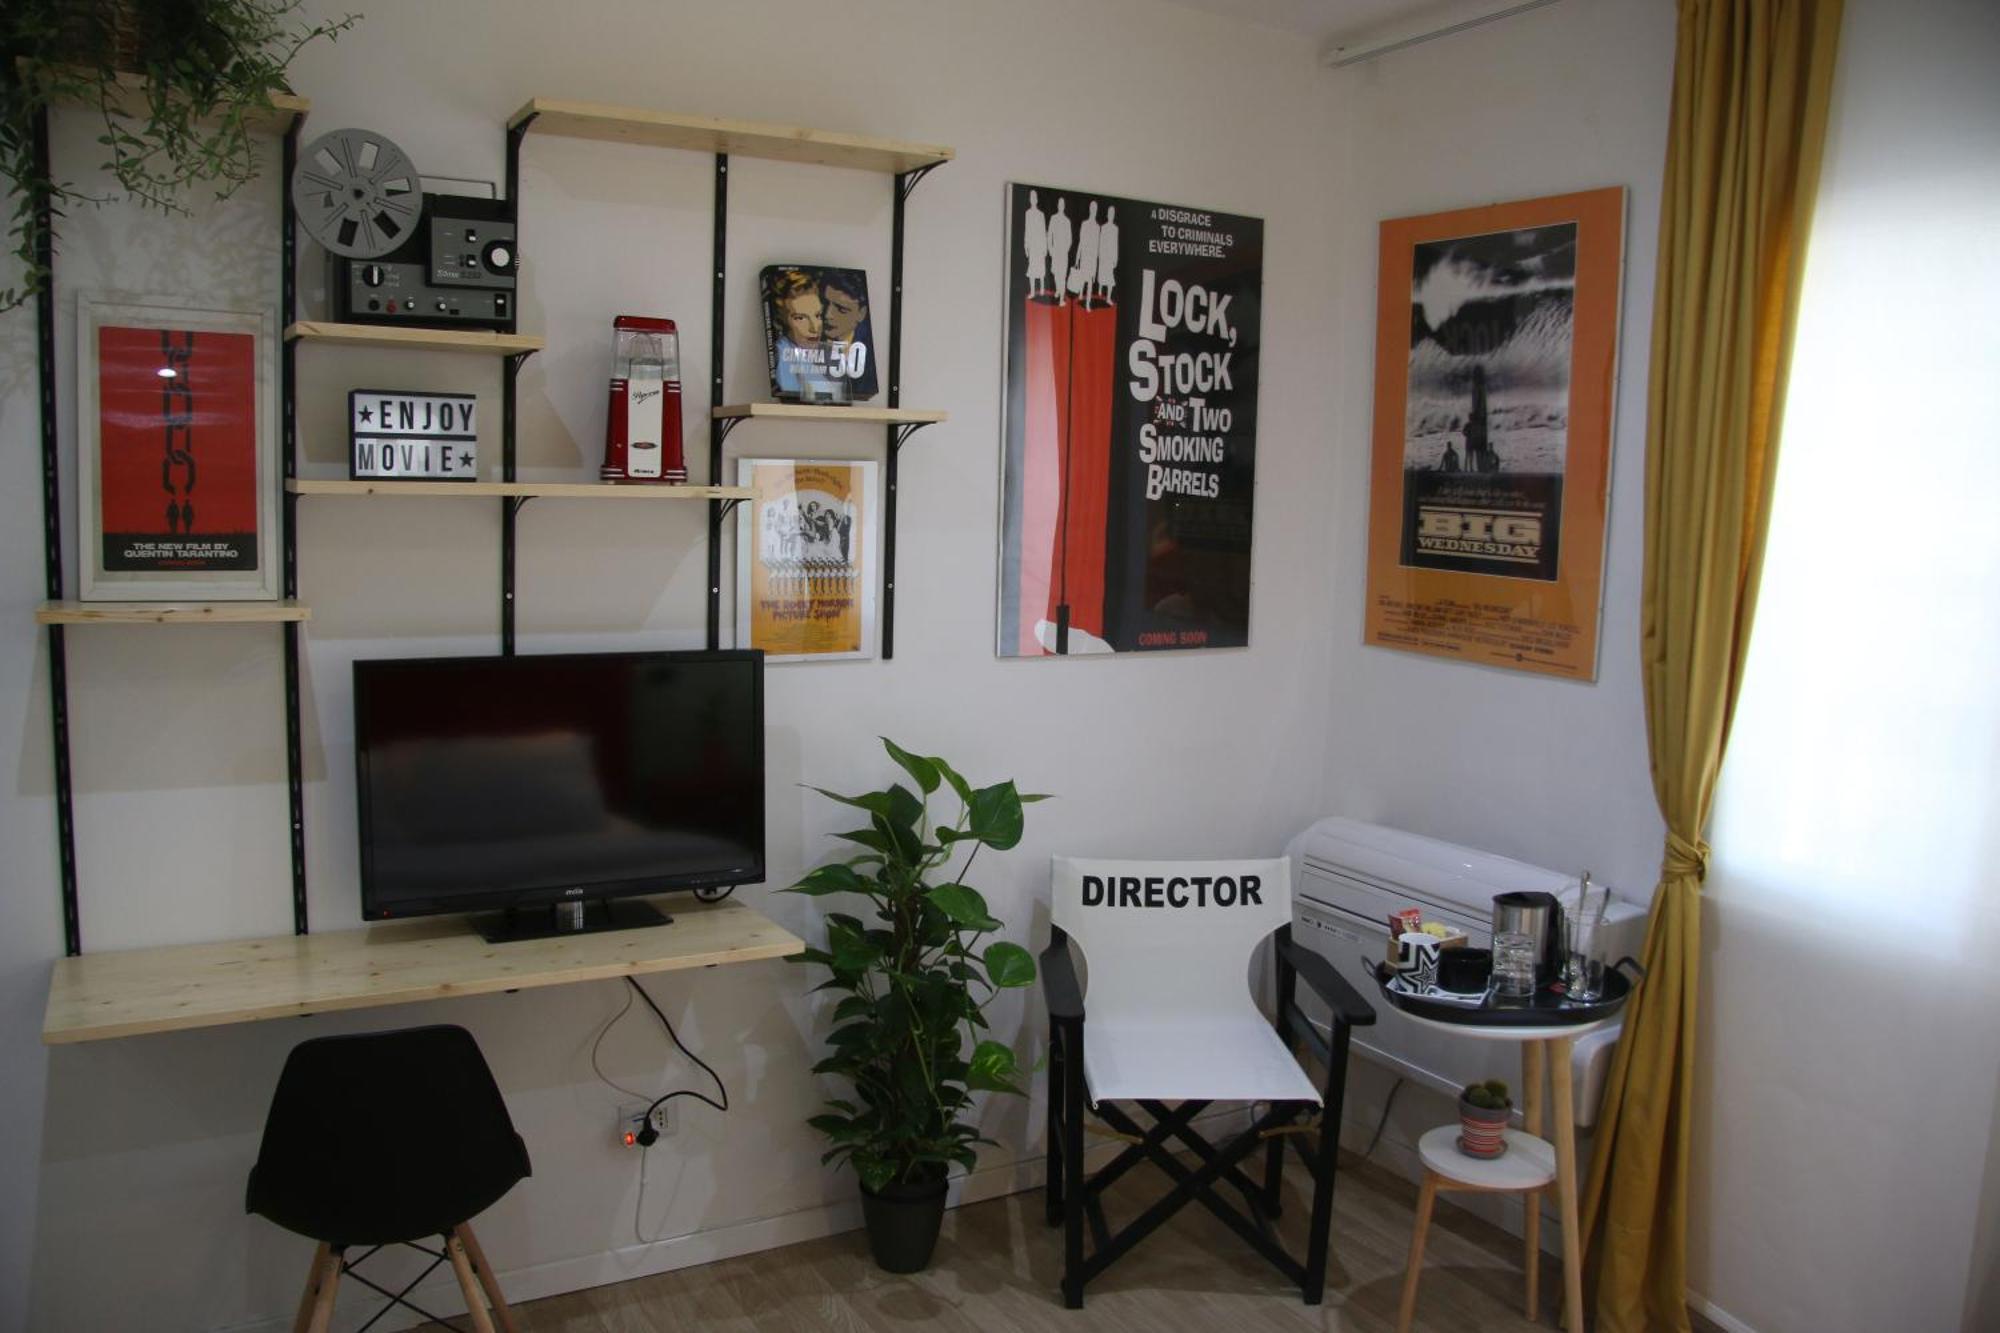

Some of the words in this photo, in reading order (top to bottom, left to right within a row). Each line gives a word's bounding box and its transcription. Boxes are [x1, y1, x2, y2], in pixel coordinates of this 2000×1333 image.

[1158, 208, 1212, 227] DISGRACE
[1149, 240, 1226, 258] EVERYWHERE.
[1161, 225, 1176, 239] TO
[1177, 227, 1233, 247] CRIMINALS
[1138, 268, 1237, 348] LOCK,
[783, 347, 825, 364] CINEMA
[829, 341, 867, 379] 50
[1129, 338, 1233, 402] STOCK
[380, 400, 474, 432] ENJOY
[1157, 403, 1185, 422] AND
[1188, 397, 1232, 433] TWO
[358, 444, 453, 473] MOVIE
[1139, 423, 1225, 463] SMOKING
[1146, 464, 1220, 501] BARRELS
[1418, 510, 1541, 546] BIG
[123, 550, 173, 558] QUENTIN
[175, 550, 239, 558] TARANTINO
[1417, 536, 1540, 558] WEDNESDAY
[1138, 631, 1177, 646] COMING
[1180, 629, 1208, 645] SOON
[1081, 875, 1263, 908] DIRECTOR
